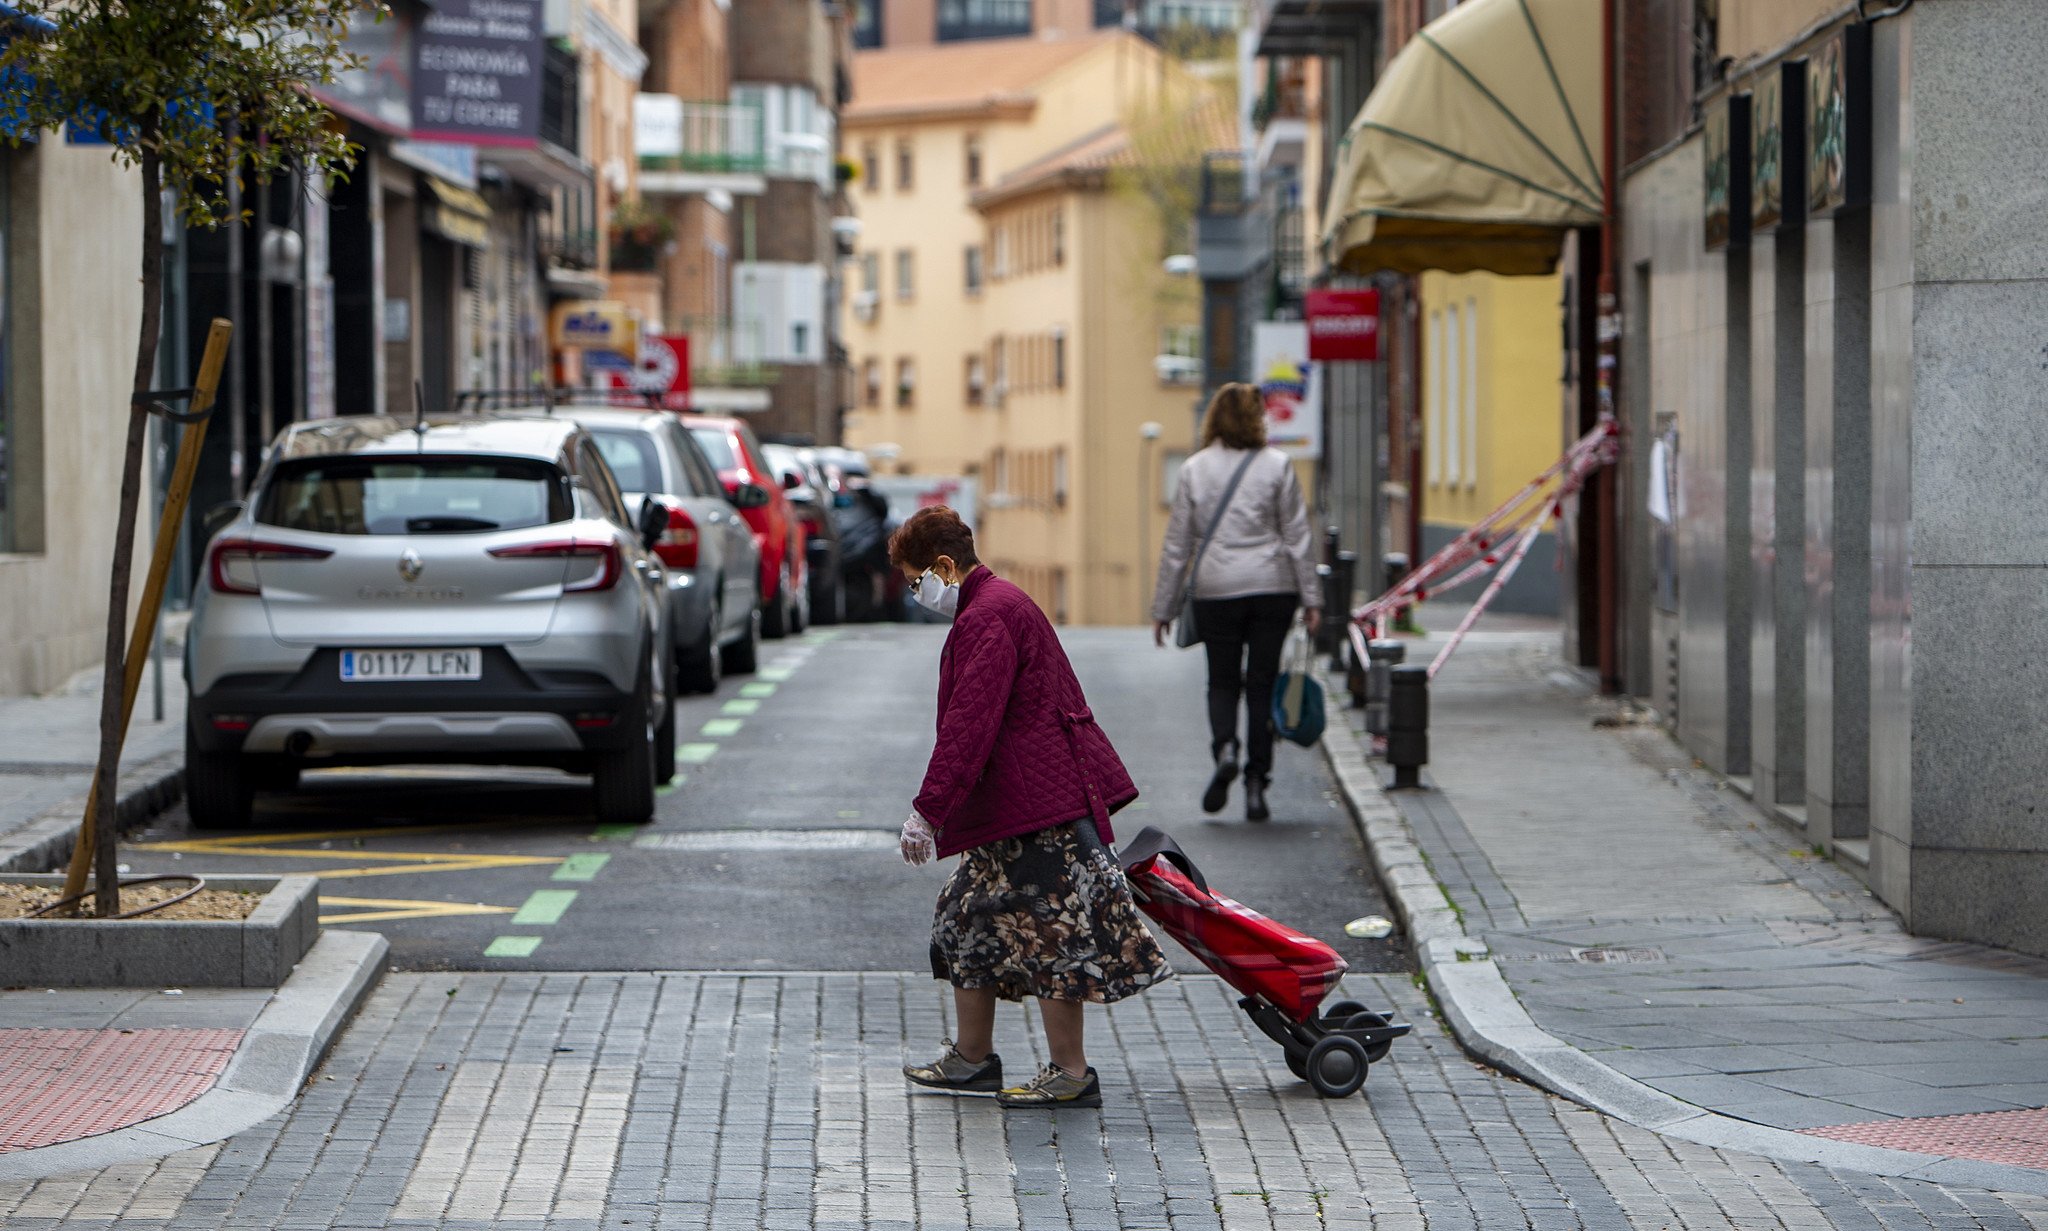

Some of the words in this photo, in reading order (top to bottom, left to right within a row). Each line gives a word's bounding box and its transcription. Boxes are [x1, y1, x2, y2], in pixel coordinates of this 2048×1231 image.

[420, 45, 530, 76] ECONOMÍA
[446, 73, 500, 98] PARA
[424, 96, 452, 122] TU
[454, 99, 520, 128] COCHE
[359, 653, 415, 675] 0117
[427, 653, 470, 675] LFN
